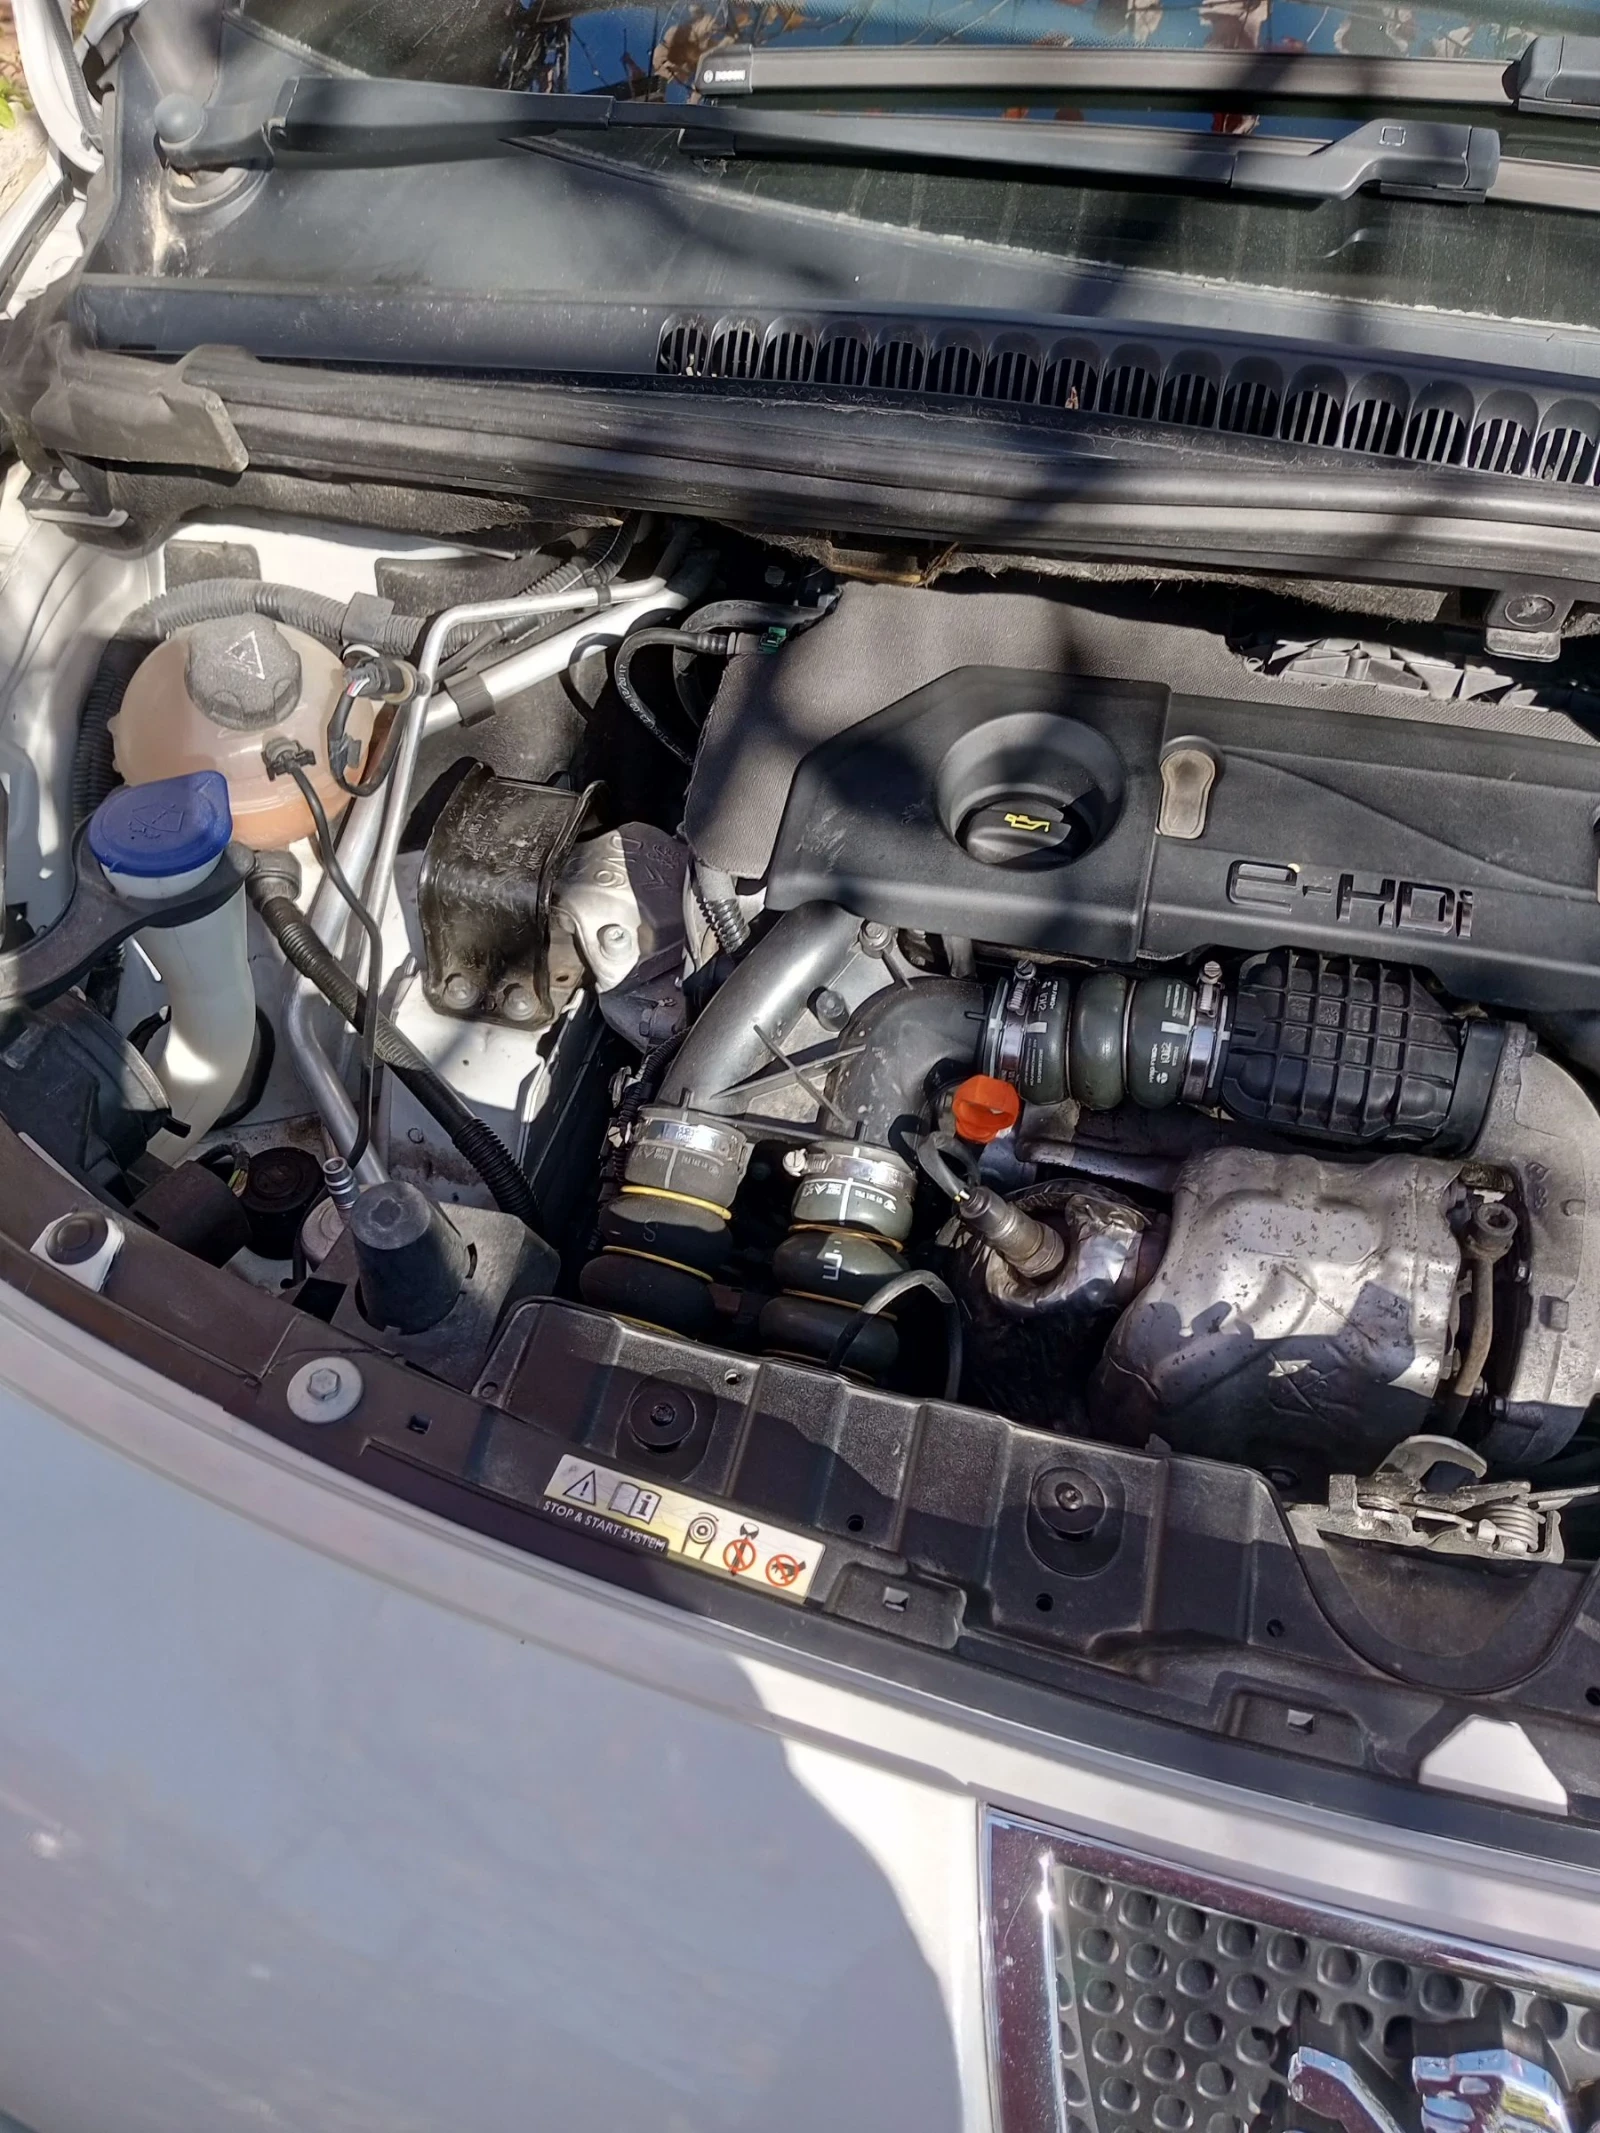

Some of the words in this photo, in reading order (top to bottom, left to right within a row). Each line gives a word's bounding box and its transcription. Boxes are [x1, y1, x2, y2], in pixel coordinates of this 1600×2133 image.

[594, 835, 643, 890] DV6
[543, 1500, 575, 1518] STOP
[575, 1510, 583, 1523] &
[584, 1514, 621, 1536] START
[621, 1528, 666, 1550] SYSTEM
